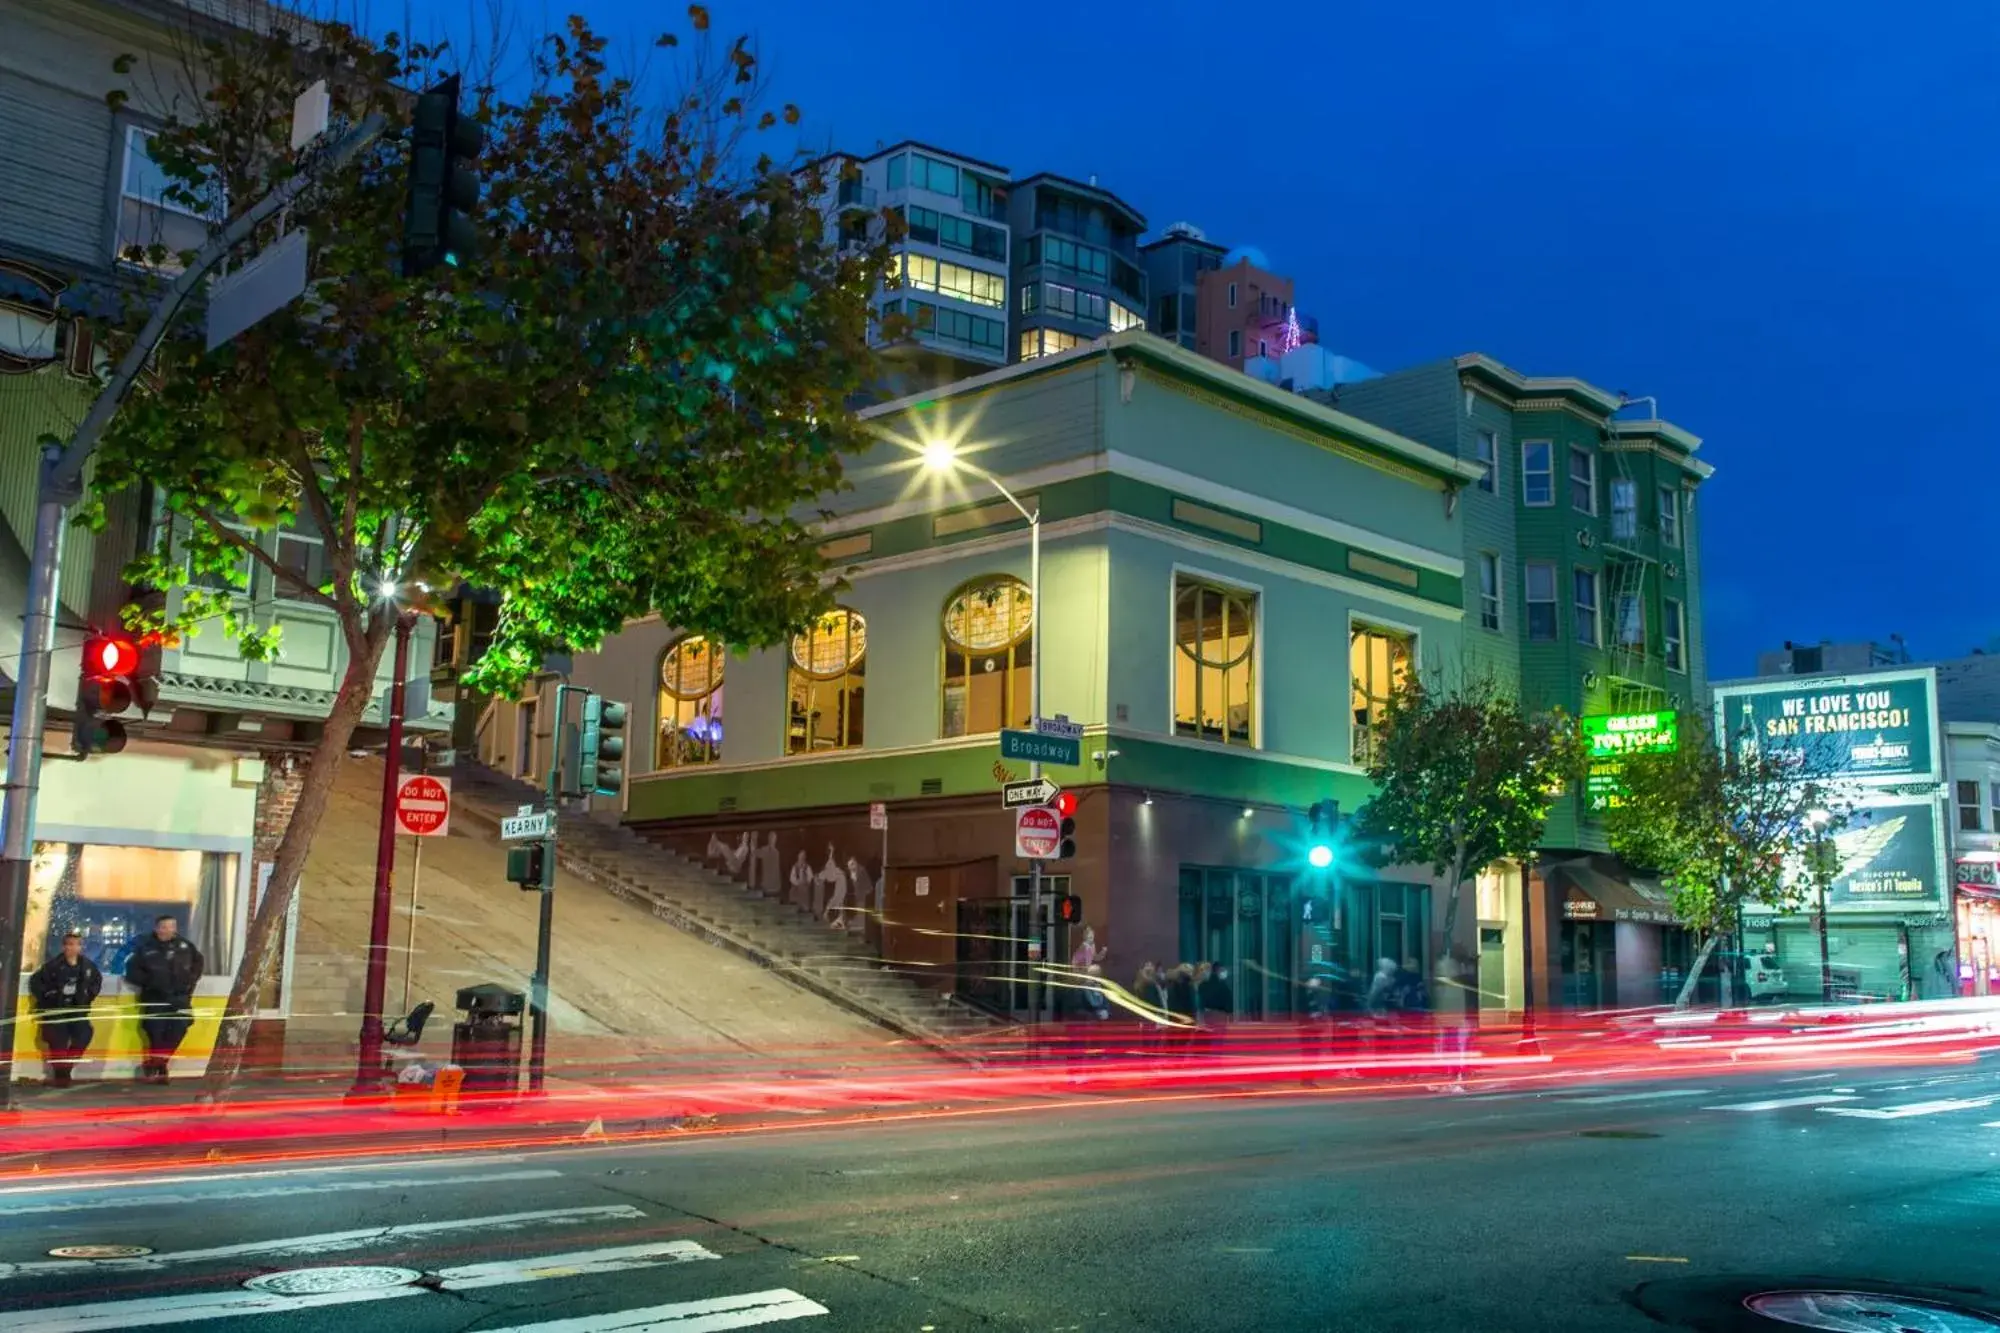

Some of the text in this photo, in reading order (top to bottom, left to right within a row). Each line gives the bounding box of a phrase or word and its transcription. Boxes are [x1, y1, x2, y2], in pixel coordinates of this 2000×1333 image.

[1782, 690, 1890, 717] WE LOVE YOU
[1041, 720, 1083, 737] BROADWAY
[1766, 708, 1909, 737] SAN FRANCISCO!
[1011, 738, 1071, 761] Broadway
[405, 786, 442, 799] DO NOT
[1009, 786, 1042, 801] ONE WAY
[406, 812, 437, 824] ENTER
[504, 816, 544, 835] KEARNY
[1023, 817, 1053, 828] DO NOT
[1024, 838, 1051, 849] ENTER
